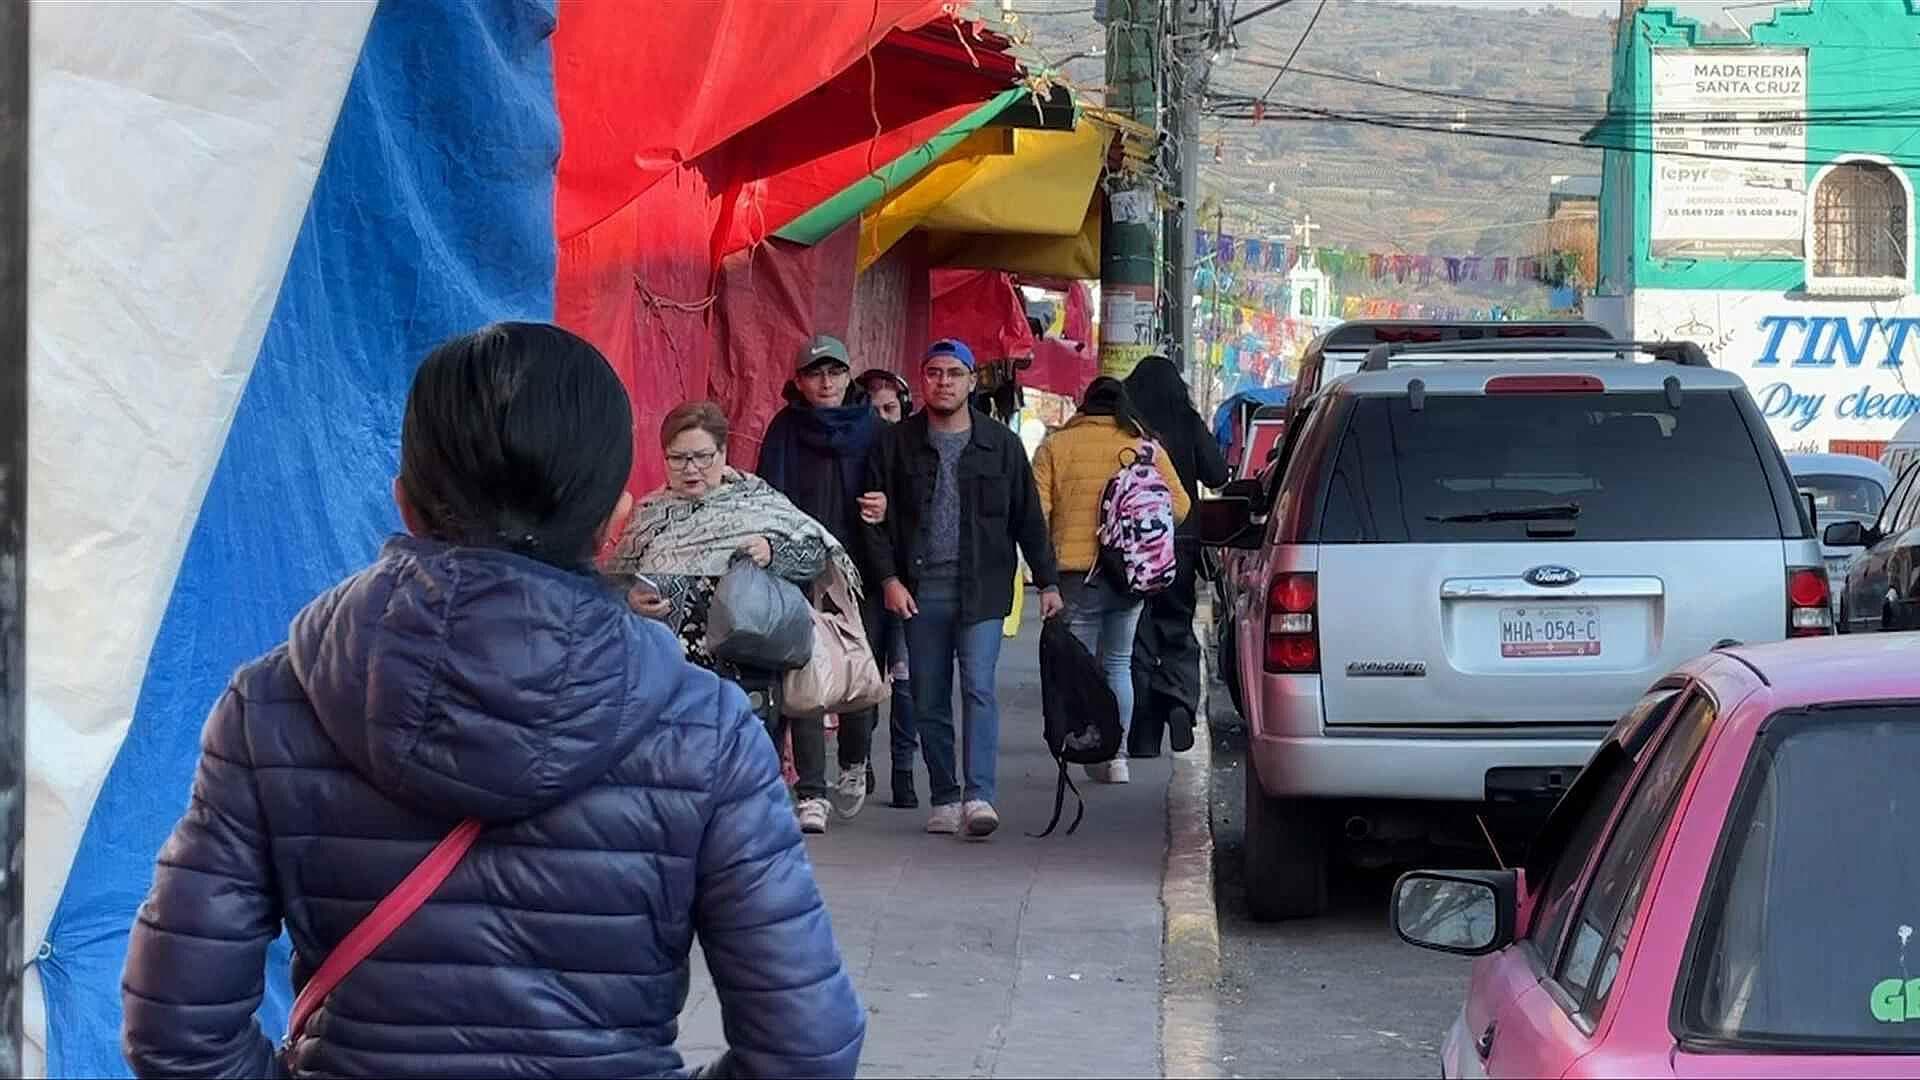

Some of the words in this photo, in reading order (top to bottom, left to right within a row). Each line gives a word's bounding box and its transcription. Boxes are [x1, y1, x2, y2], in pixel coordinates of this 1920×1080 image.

[1694, 65, 1802, 78] MADERERIA
[1696, 82, 1750, 93] SANTA
[1755, 82, 1801, 93] CRUZ
[1755, 315, 1920, 367] TINT
[1758, 382, 1825, 432] Dry
[1535, 568, 1569, 583] Ford
[1503, 620, 1597, 641] MHA-054-C
